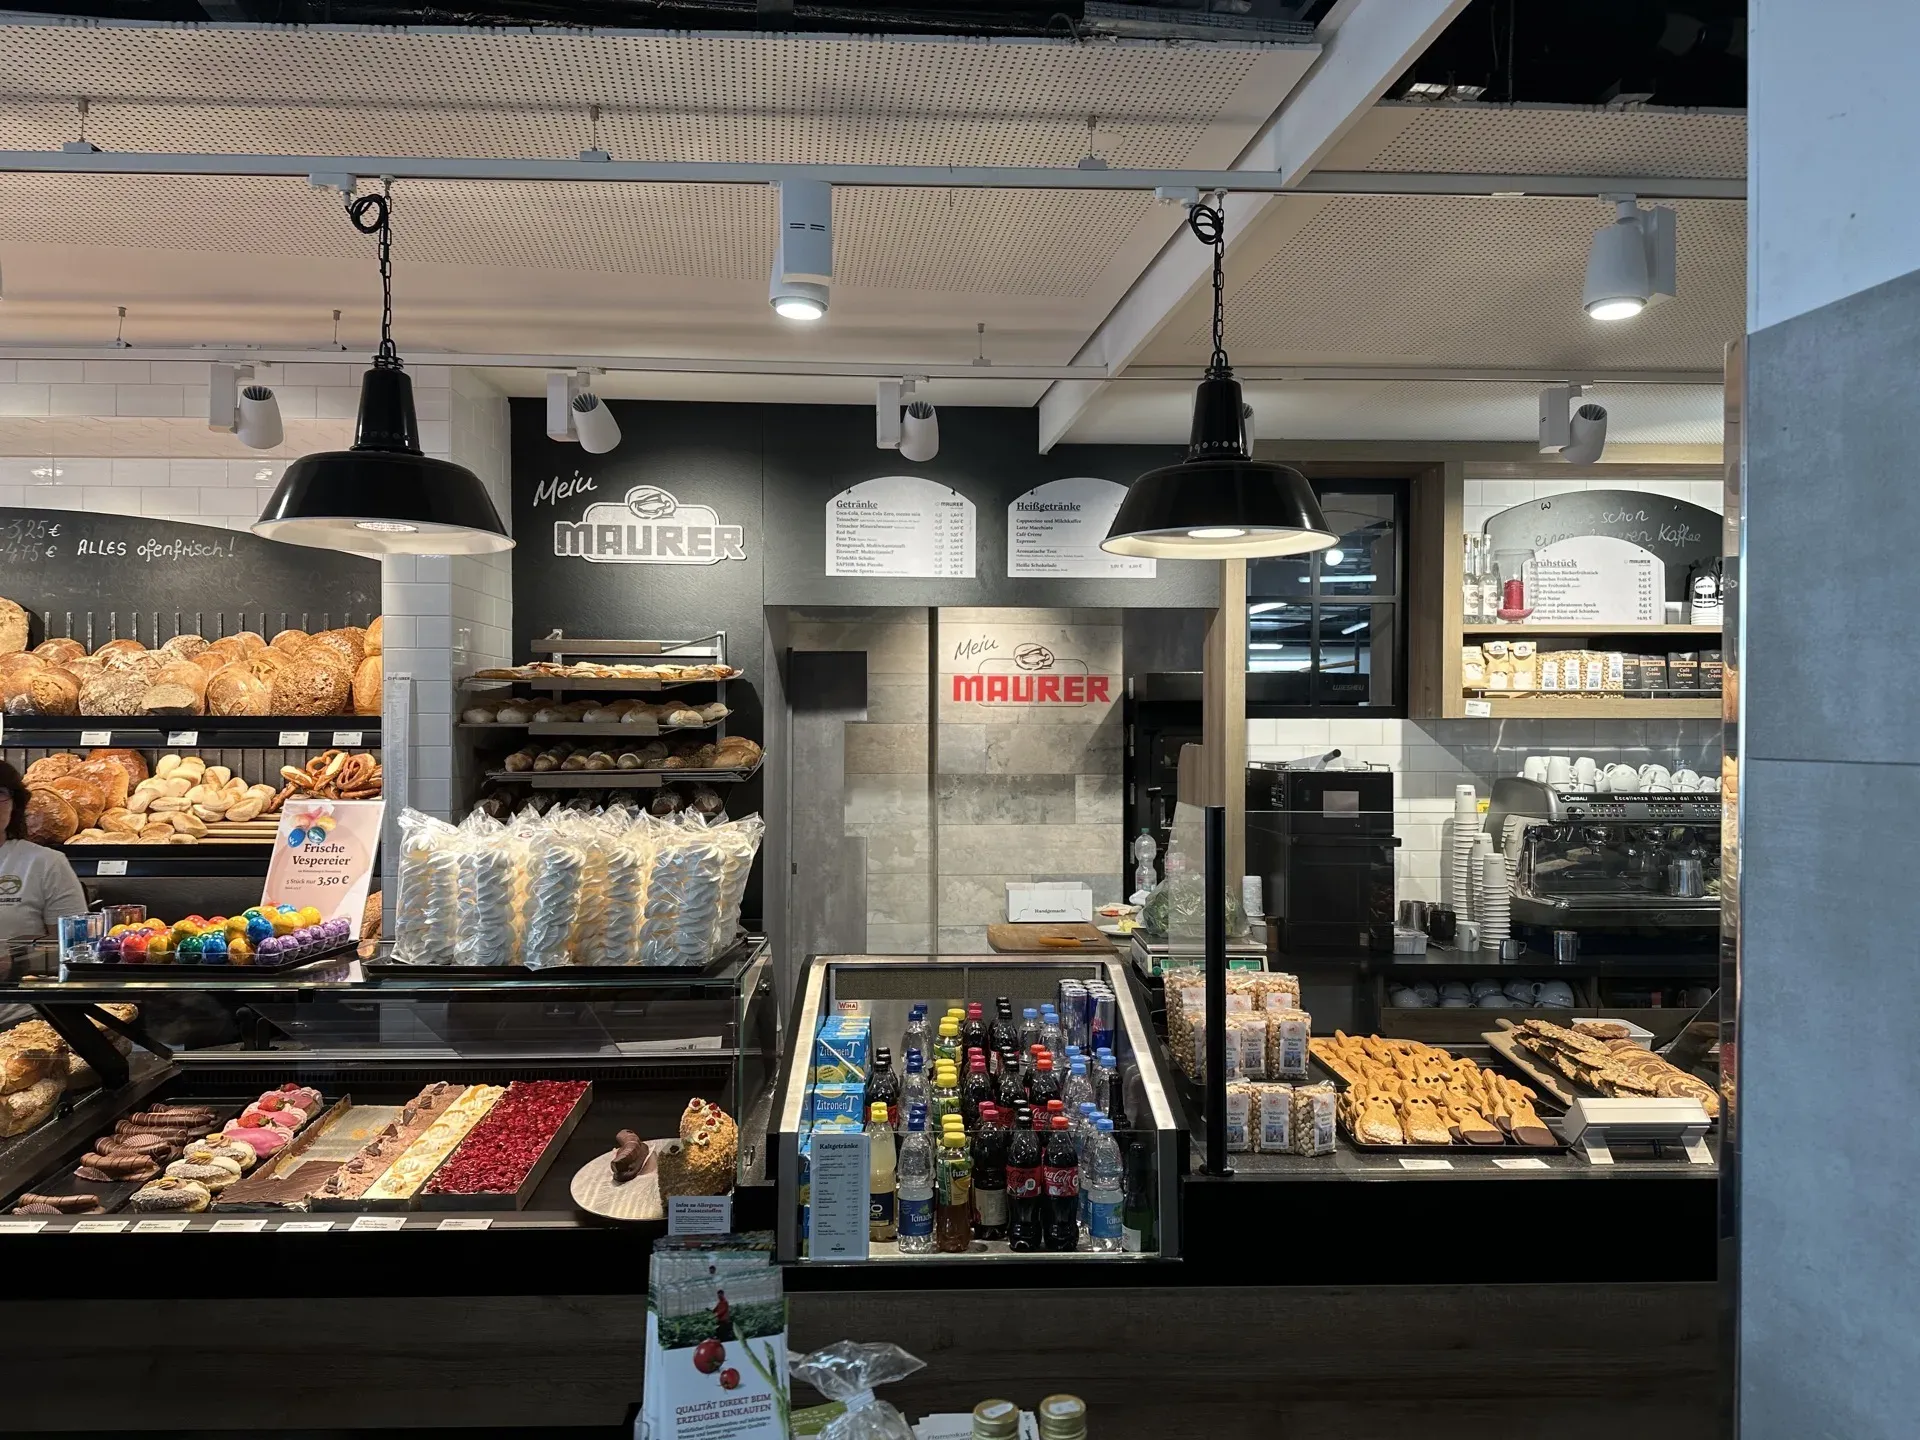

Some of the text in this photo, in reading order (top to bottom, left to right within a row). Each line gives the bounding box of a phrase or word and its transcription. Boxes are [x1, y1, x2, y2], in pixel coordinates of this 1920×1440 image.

[533, 470, 597, 506] Mein
[836, 500, 878, 508] Getränke
[1017, 502, 1081, 512] Heißgetränke
[1602, 508, 1649, 524] schon
[555, 522, 745, 558] MAURER
[1657, 523, 1701, 547] Kaffee
[77, 538, 127, 556] ALLES
[1530, 559, 1577, 568] Frühstück
[954, 635, 999, 660] Mein
[953, 675, 1110, 702] MAURER
[304, 843, 345, 853] Frische
[292, 855, 351, 867] Vespereier
[317, 876, 339, 886] 3,50
[342, 875, 349, 884] €
[952, 1169, 968, 1177] fuze
[676, 1393, 771, 1415] QUALITÄT DIREKT BEIM
[677, 1403, 771, 1425] ERZEUGER EINKAUFEN
